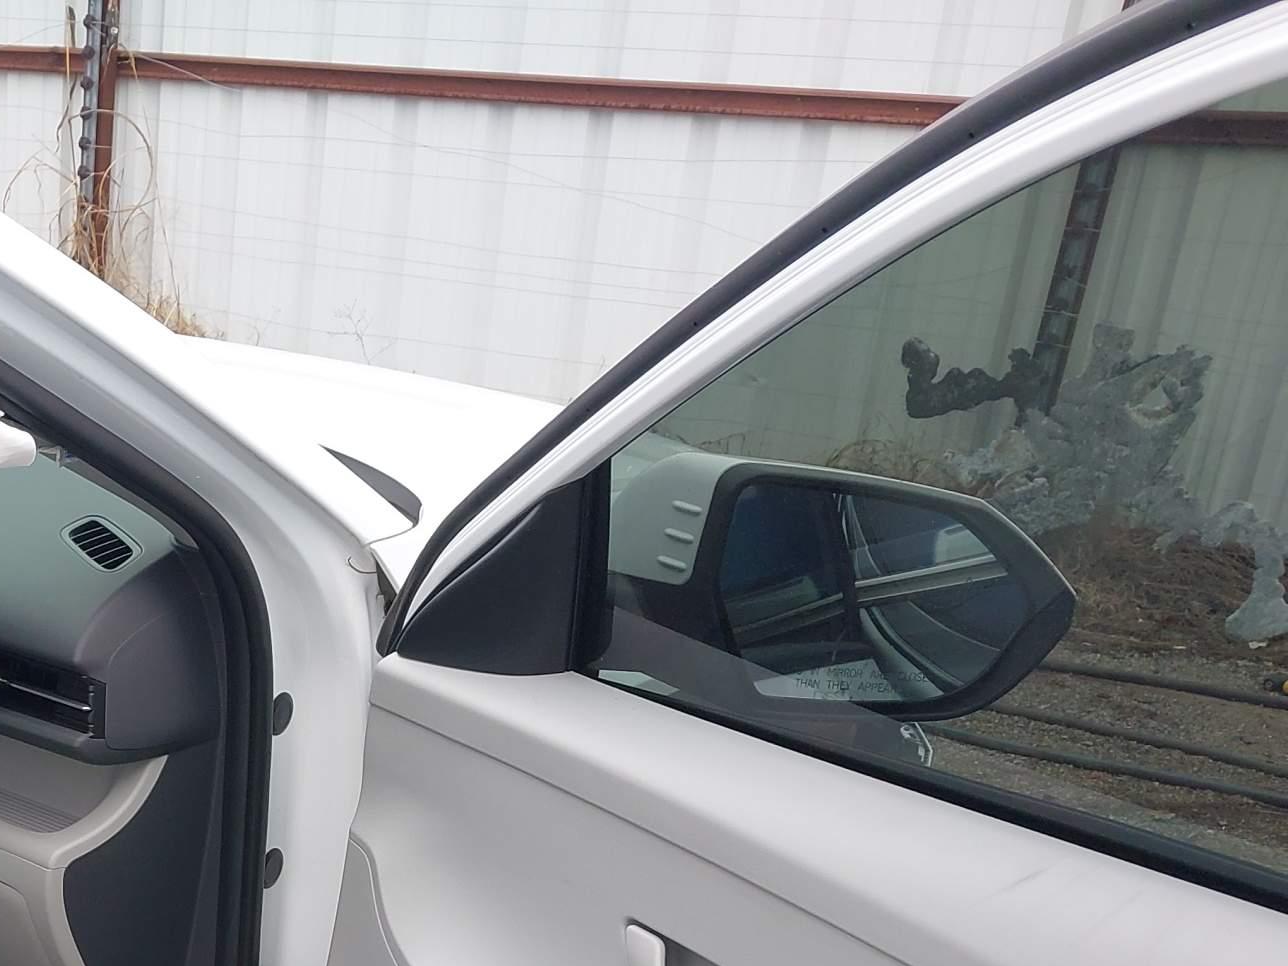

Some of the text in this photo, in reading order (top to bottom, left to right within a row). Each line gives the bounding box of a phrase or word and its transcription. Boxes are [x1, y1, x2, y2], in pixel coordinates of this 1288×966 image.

[826, 667, 864, 679] MIRROR
[795, 678, 821, 689] THAN
[826, 679, 850, 691] THEY
